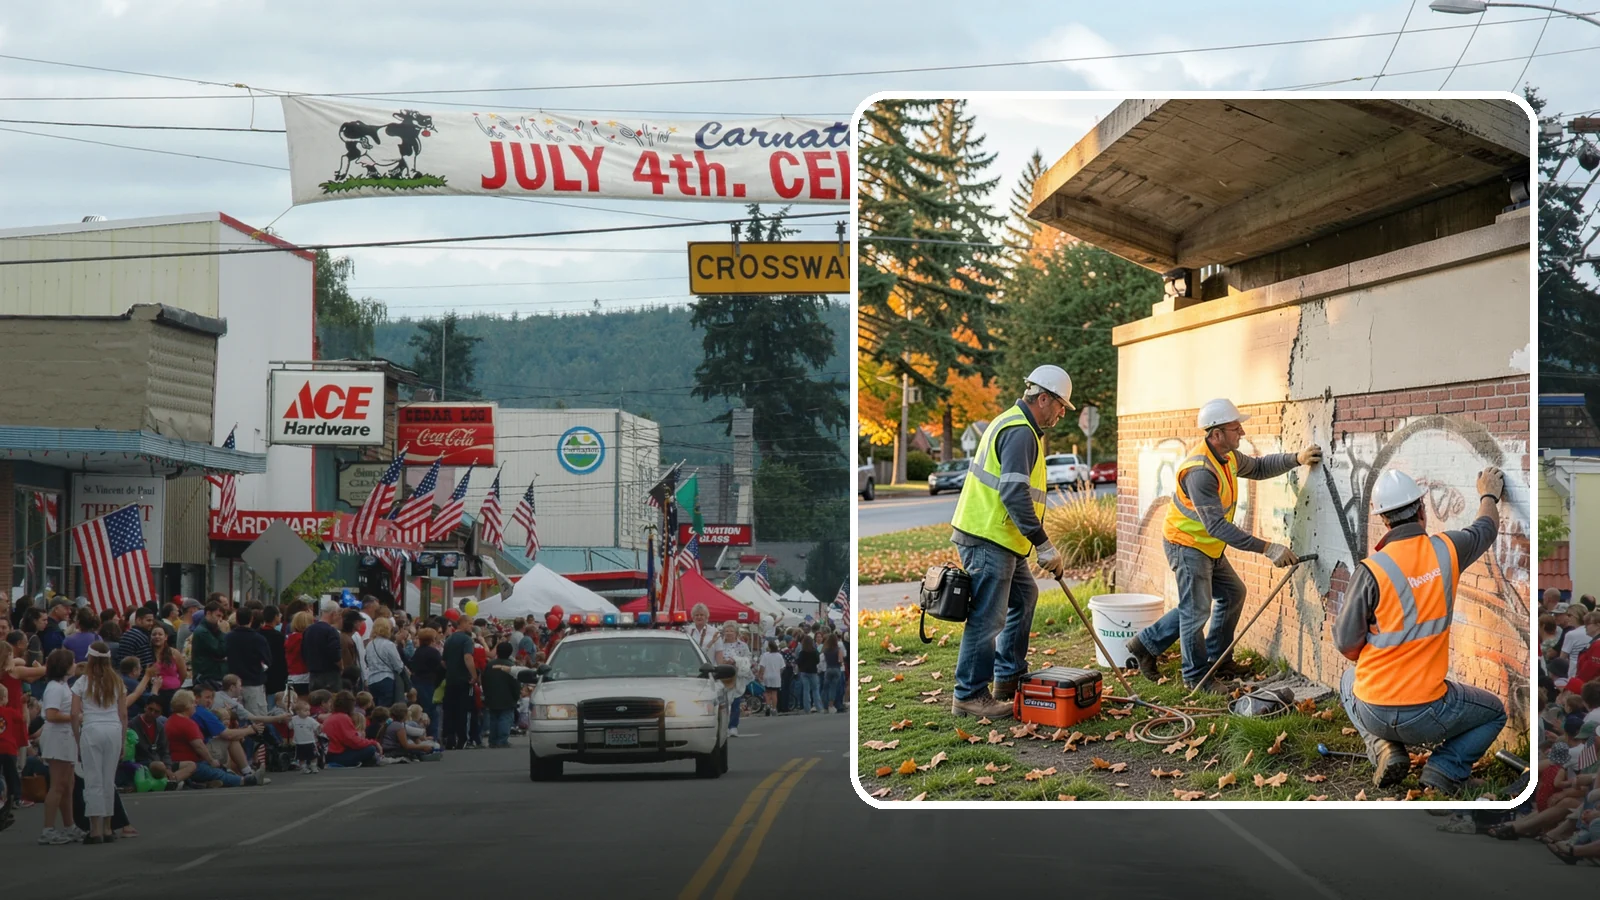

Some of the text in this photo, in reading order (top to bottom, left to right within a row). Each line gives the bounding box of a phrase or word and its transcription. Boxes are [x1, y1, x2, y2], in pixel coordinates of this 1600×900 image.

[481, 141, 605, 192] JULY
[632, 150, 746, 197] 4th.
[697, 254, 850, 280] CROSSWA
[283, 380, 373, 420] ACE
[406, 409, 485, 421] CEDAR LOG
[283, 421, 371, 436] Hardware
[416, 428, 477, 447] Coca-Cola
[353, 467, 387, 480] Simpl
[83, 485, 155, 495] St. Vincent de Paul
[81, 503, 154, 522] THT
[688, 526, 741, 535] CRNATION
[699, 535, 730, 543] GLASS
